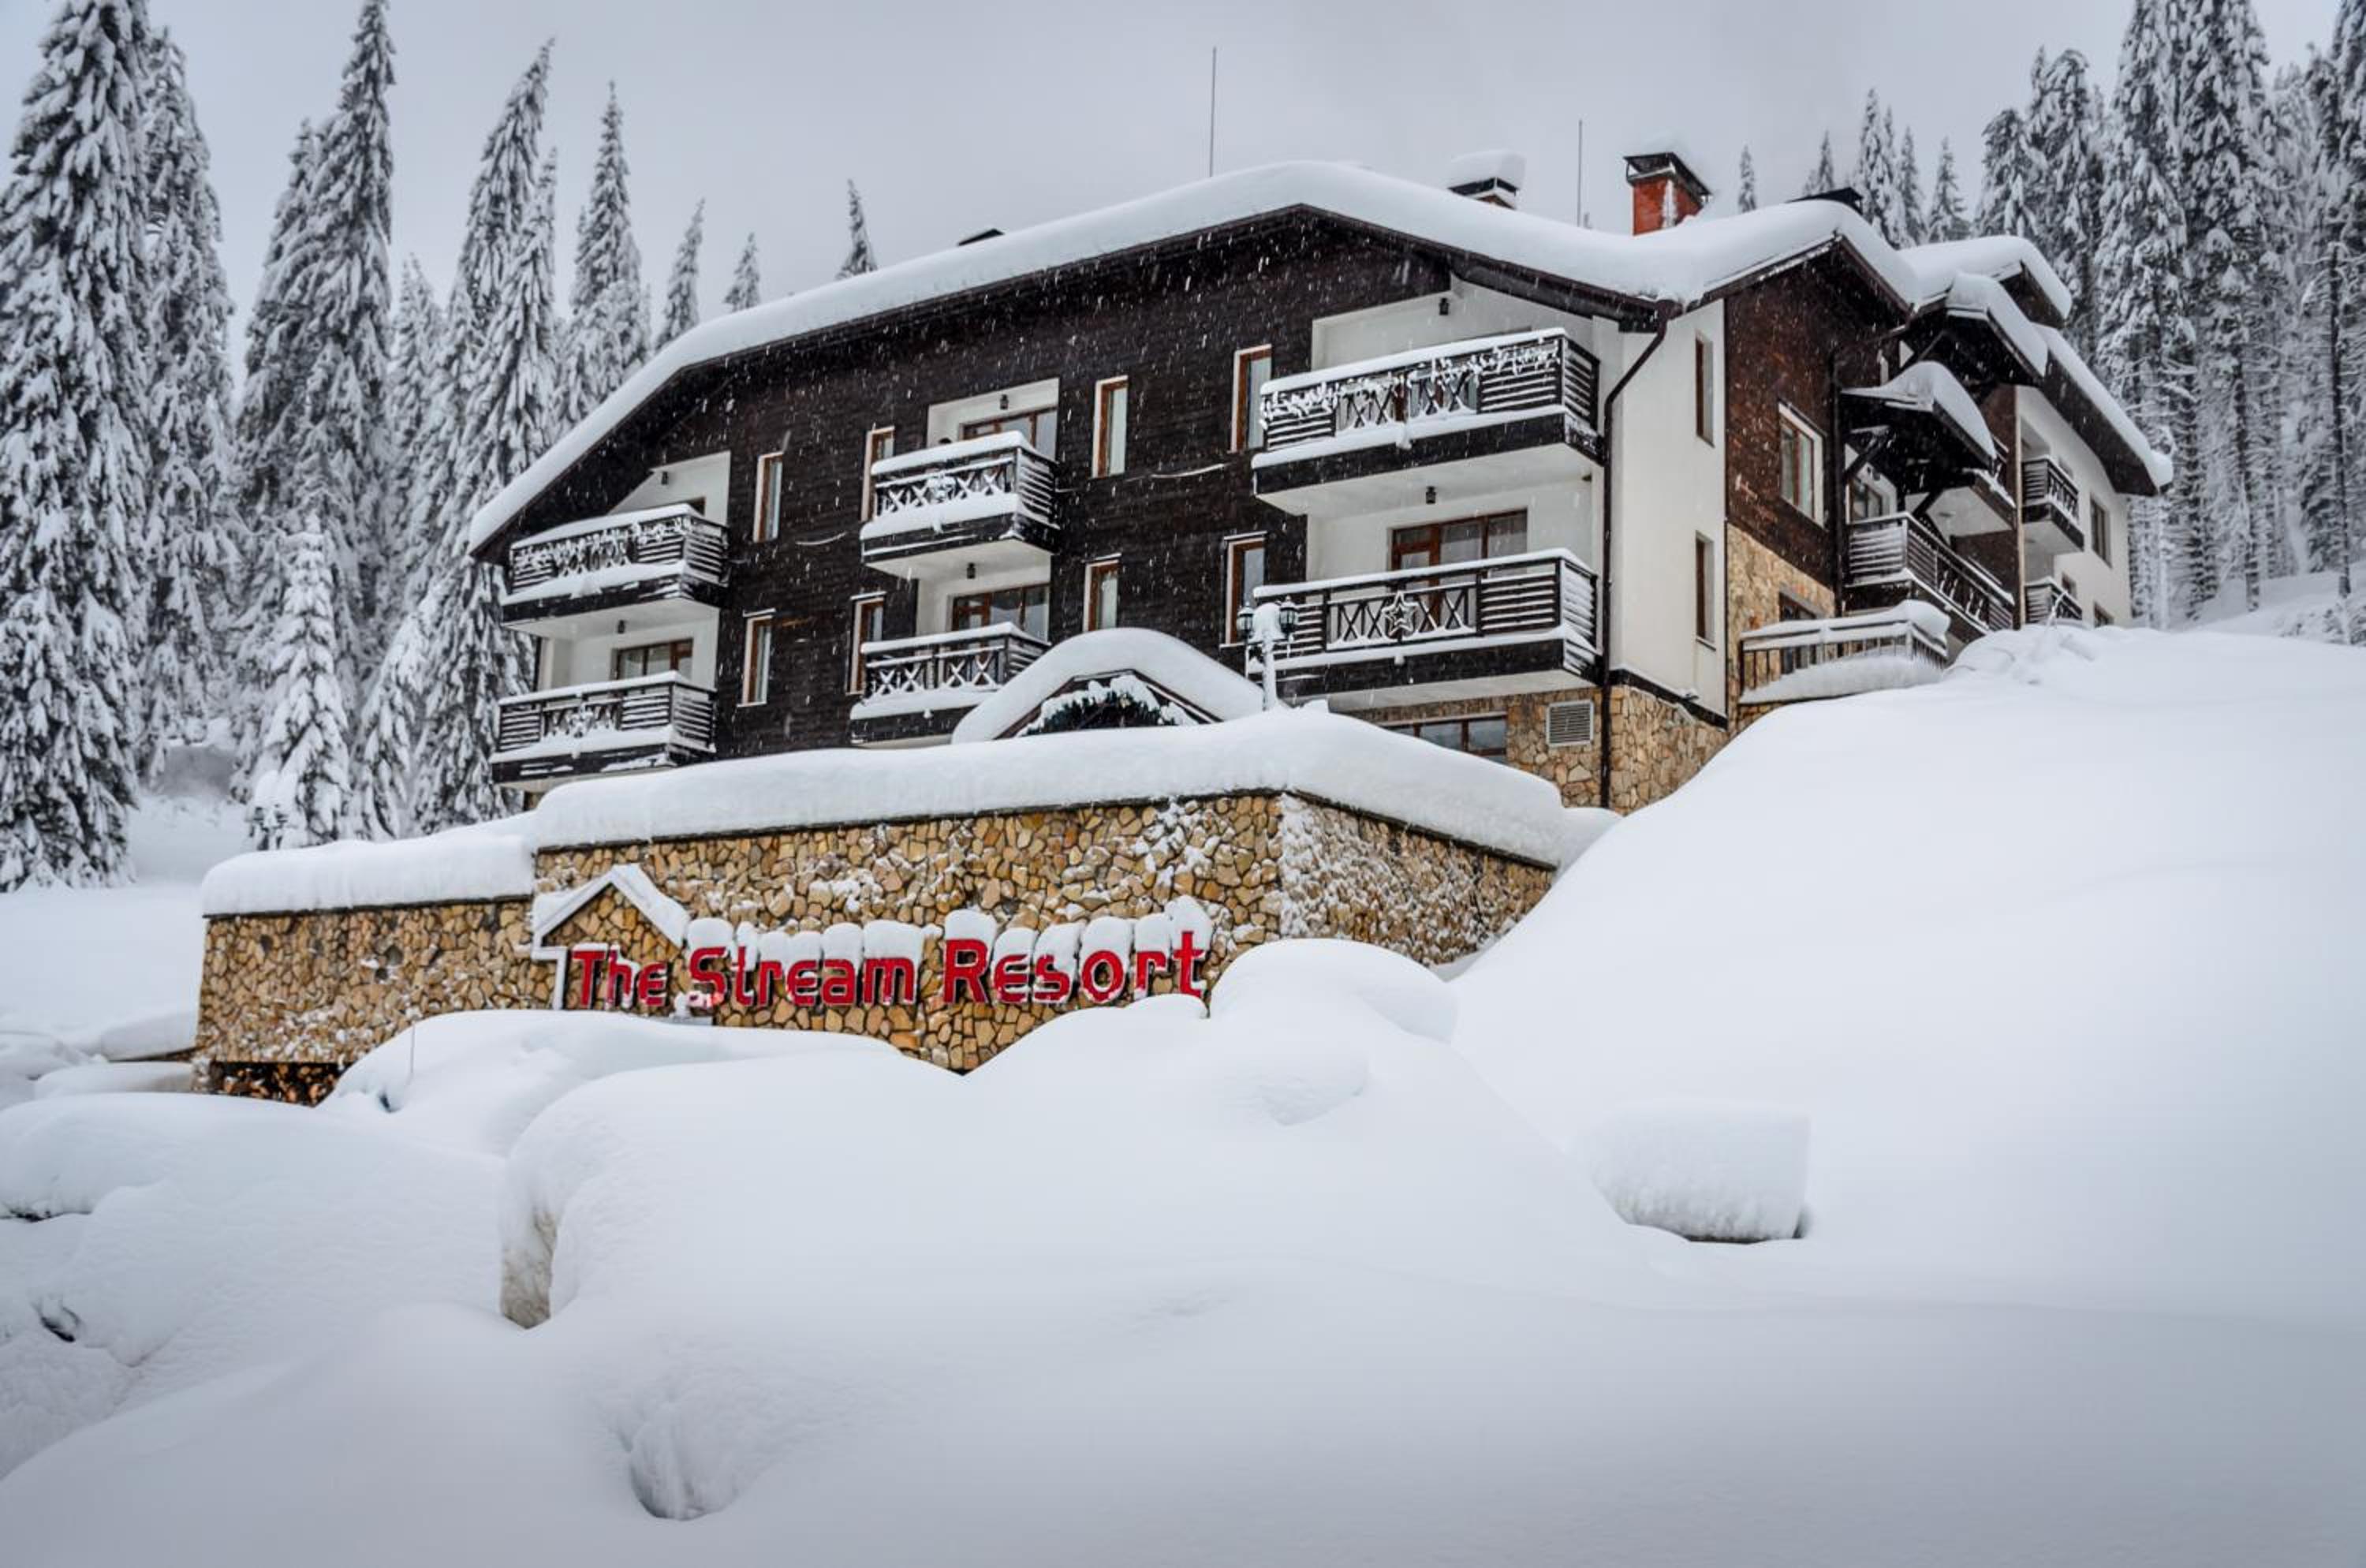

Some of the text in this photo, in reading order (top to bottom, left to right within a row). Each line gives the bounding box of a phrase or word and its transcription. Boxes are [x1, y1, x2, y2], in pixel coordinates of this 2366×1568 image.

[572, 930, 1207, 1009] The Stream Resort
